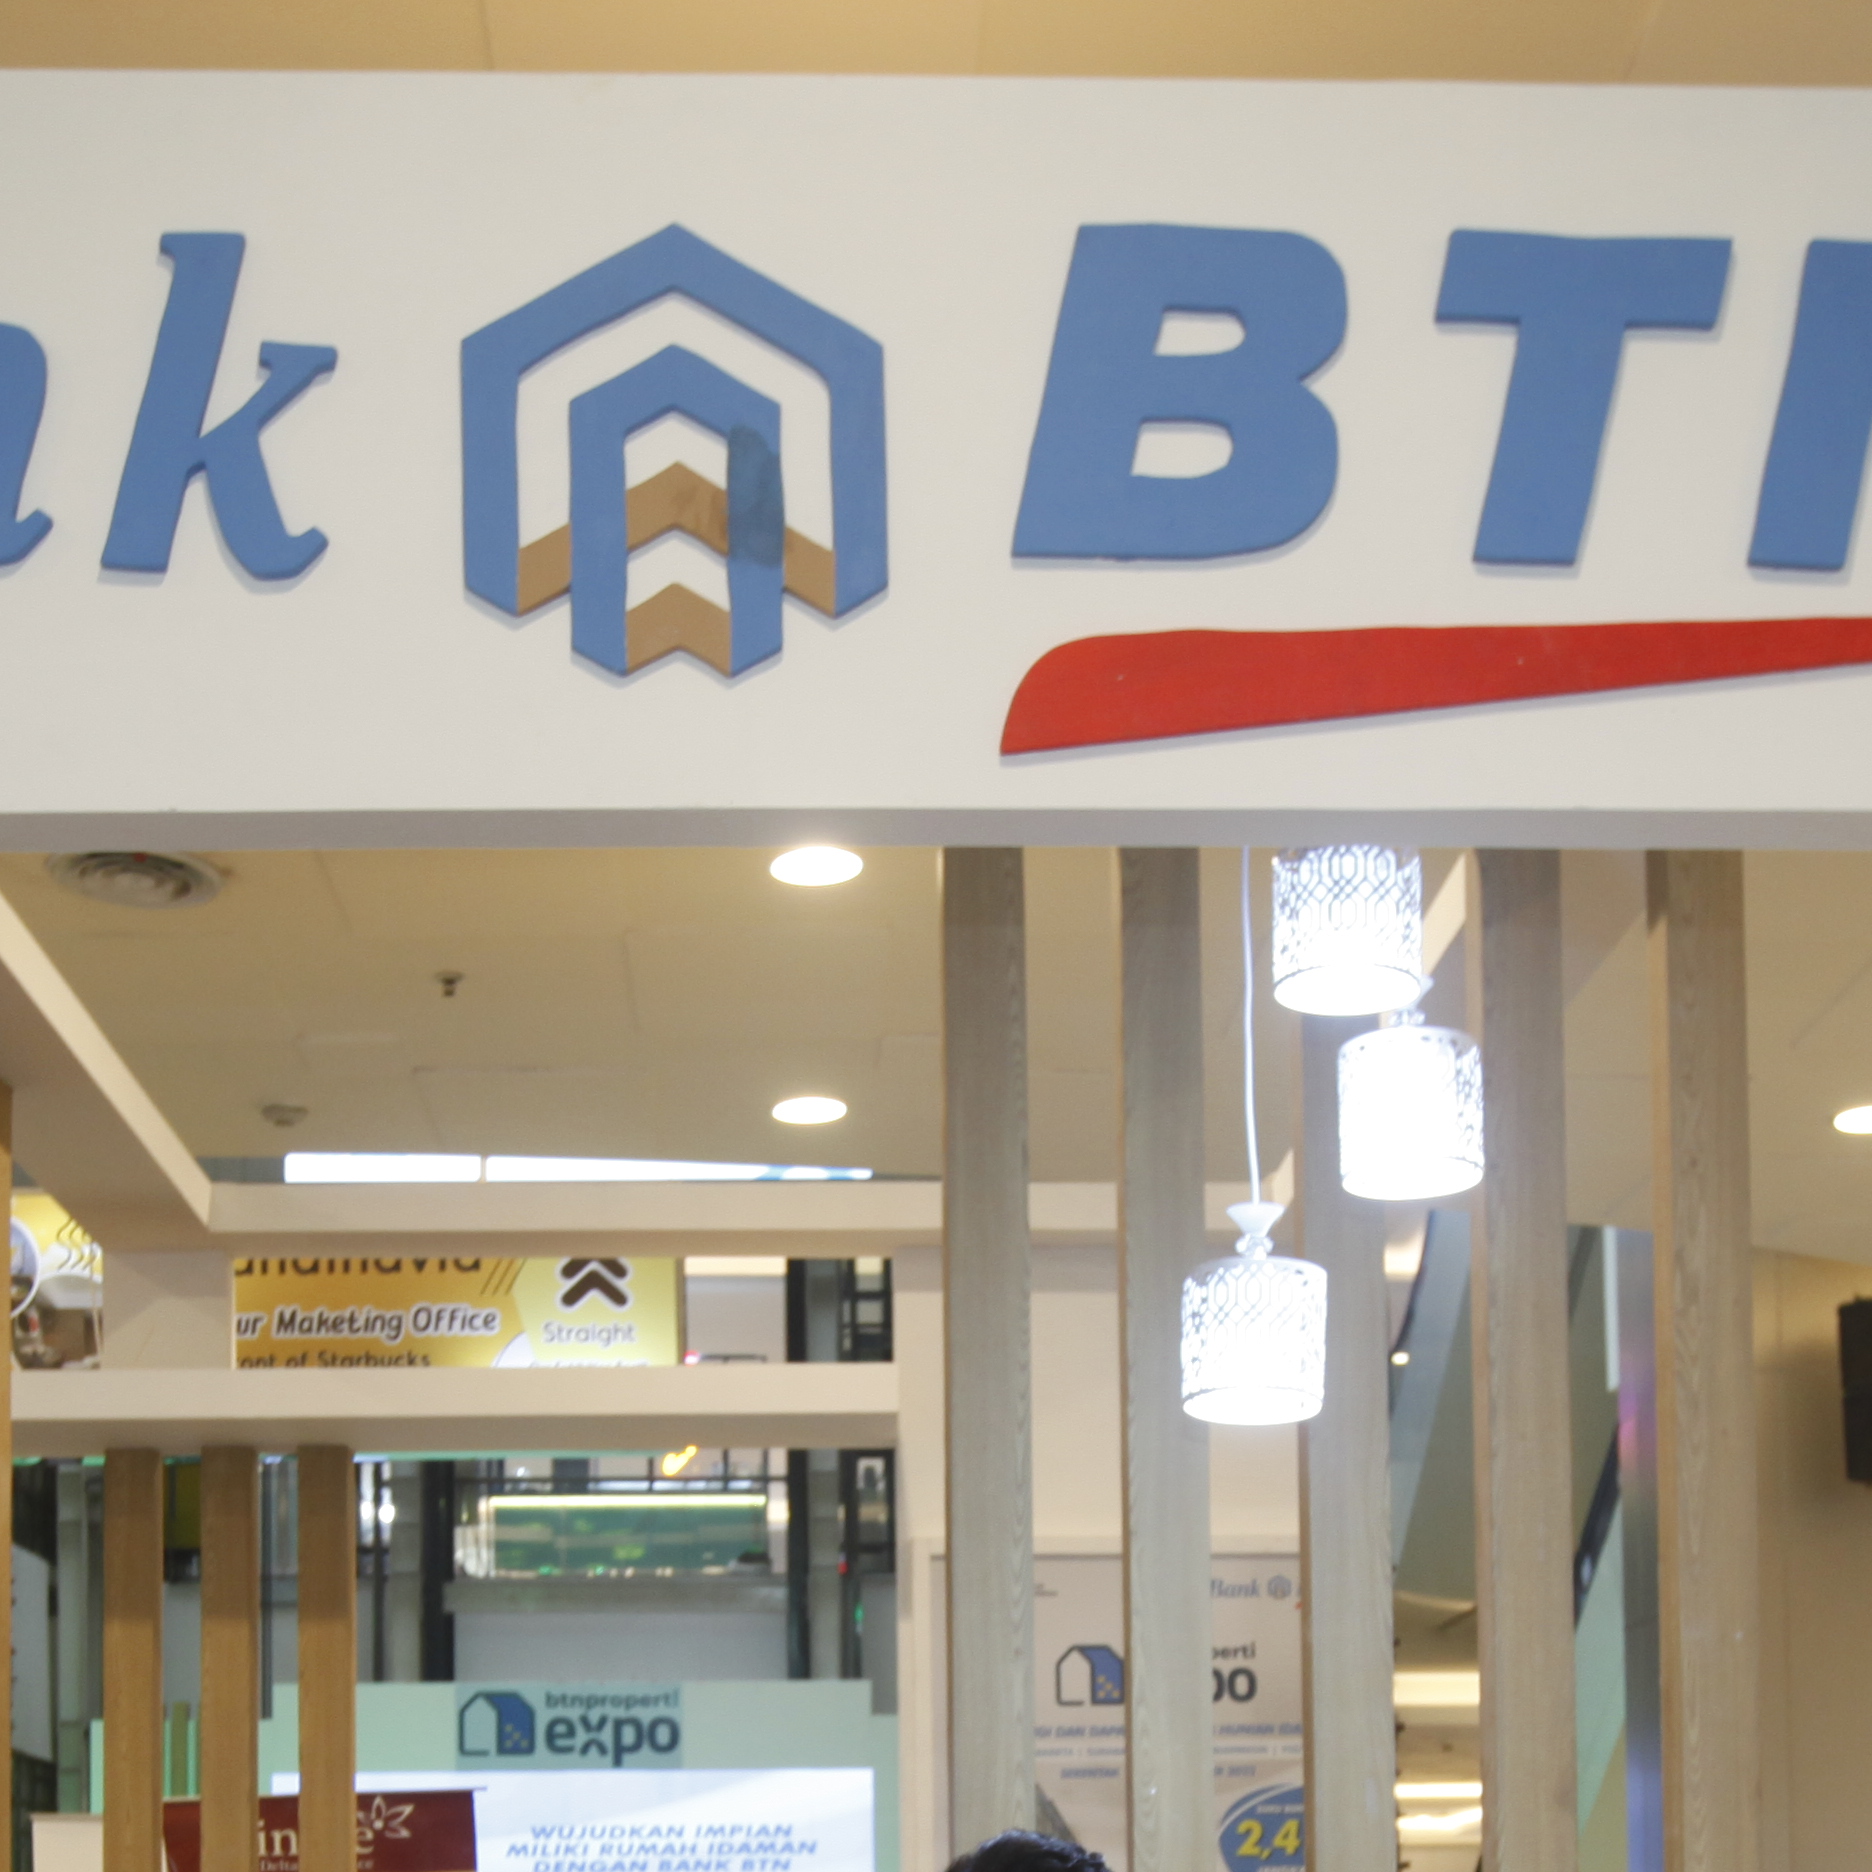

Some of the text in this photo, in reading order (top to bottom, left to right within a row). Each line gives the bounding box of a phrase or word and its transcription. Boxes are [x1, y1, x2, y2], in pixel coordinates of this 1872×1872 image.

[275, 1306, 404, 1342] Maketing
[411, 1303, 498, 1334] Office
[542, 1321, 636, 1347] Straight
[545, 1687, 679, 1711] btnproperti
[544, 1713, 681, 1767] expo
[530, 1823, 794, 1840] WUJUDKAN IMPIAN
[1236, 1818, 1302, 1861] 2,4
[506, 1840, 818, 1858] MILIKI RUMAH IDAMAN
[658, 1858, 732, 1872] BANK
[741, 1858, 792, 1872] BTN
